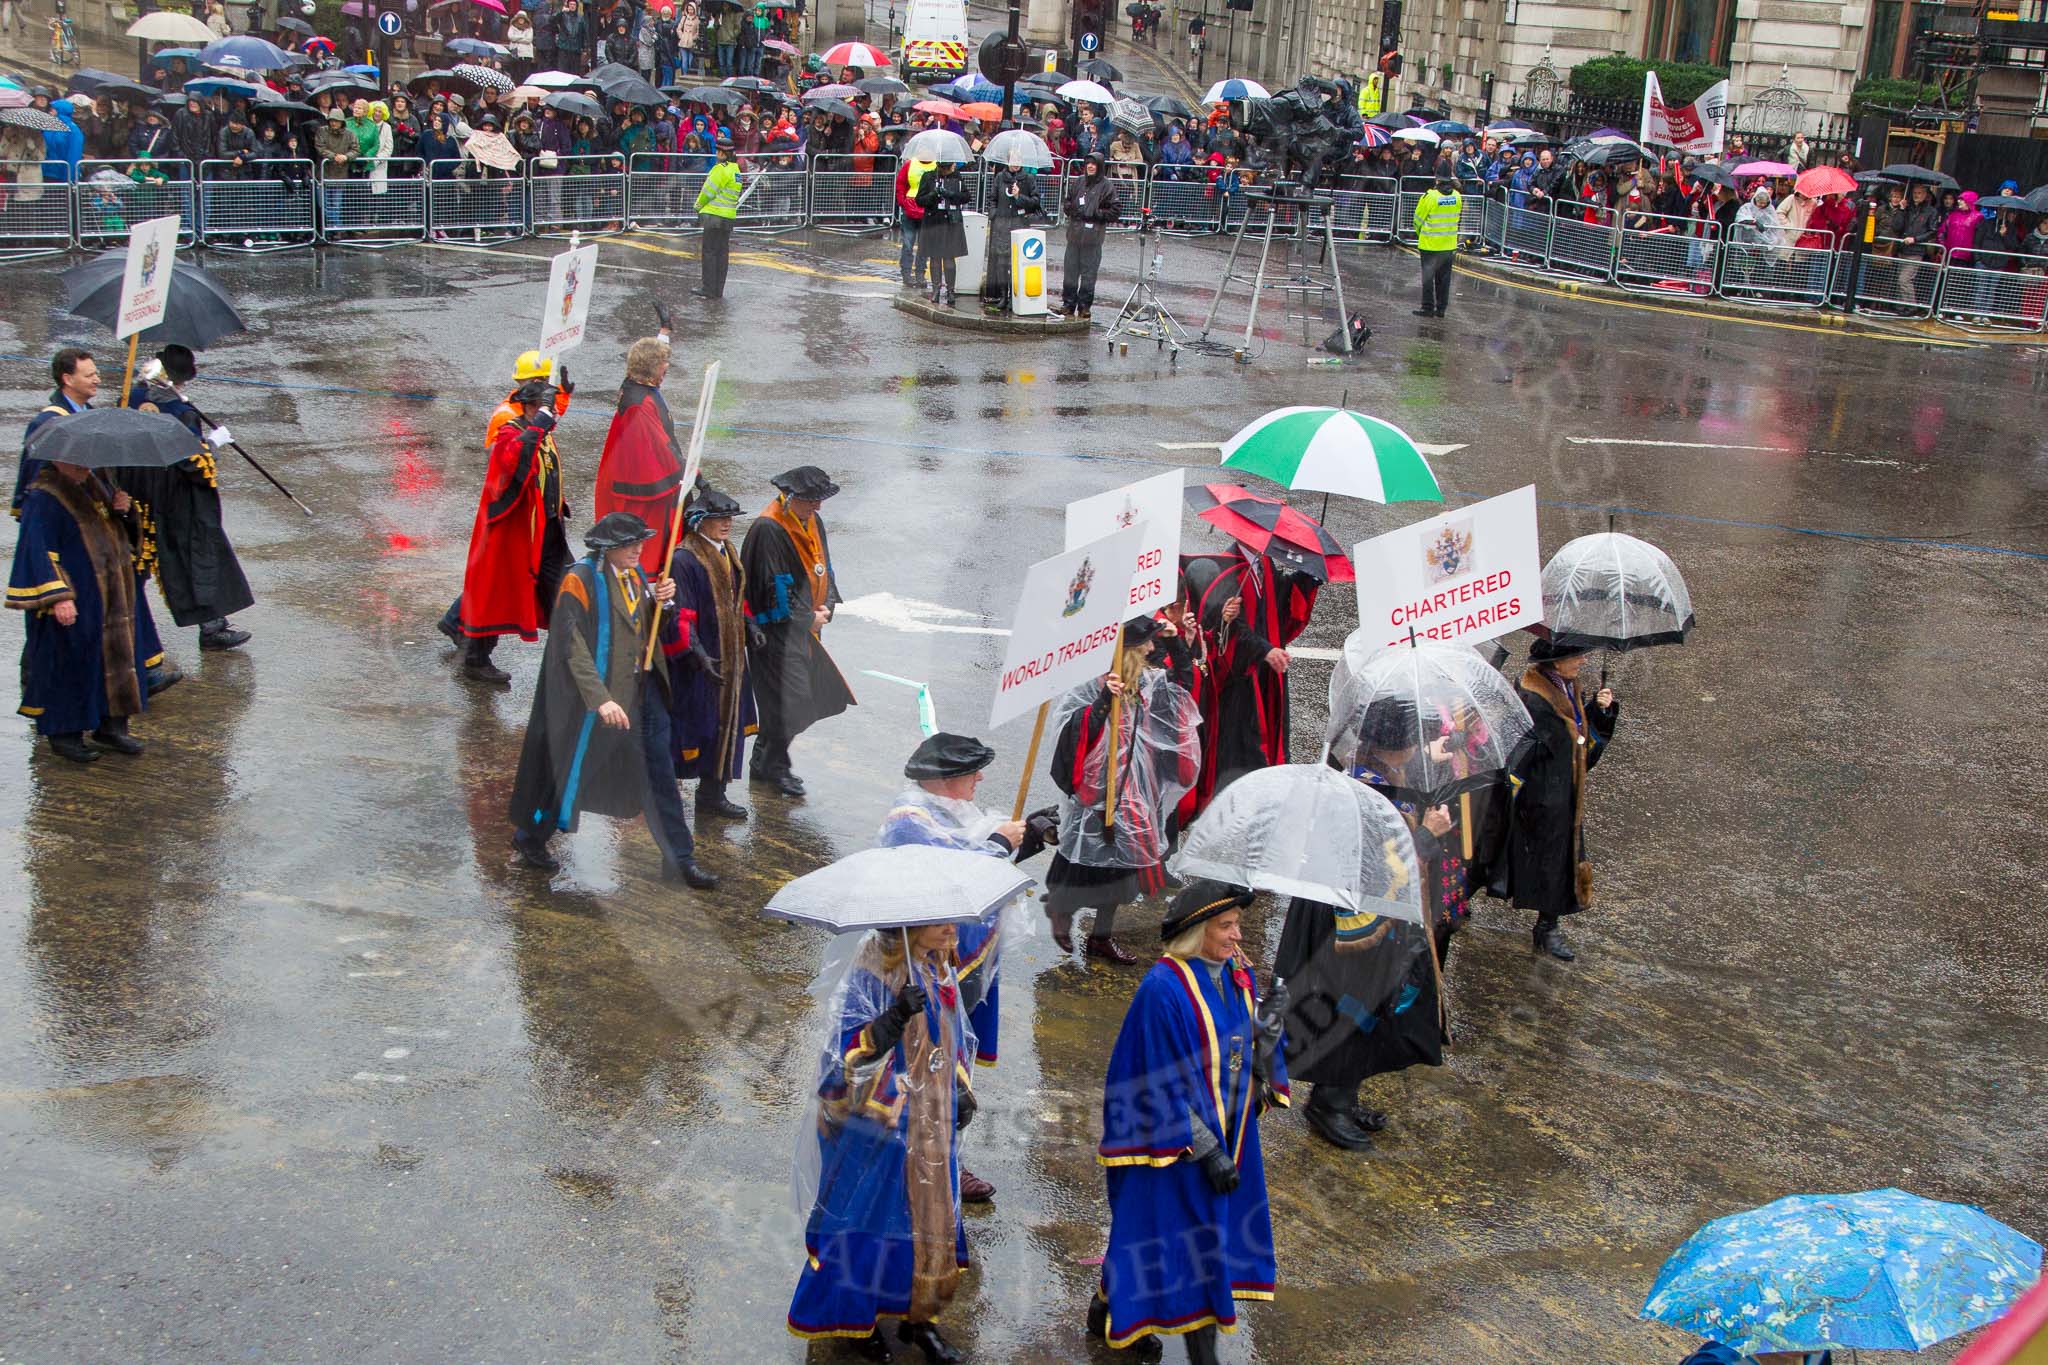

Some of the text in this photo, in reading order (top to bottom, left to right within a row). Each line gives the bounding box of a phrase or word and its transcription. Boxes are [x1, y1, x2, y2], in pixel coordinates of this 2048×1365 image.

[1668, 126, 1697, 138] ANCER
[1387, 598, 1521, 647] RETARIES
[1391, 570, 1511, 626] CHARTERED
[1001, 622, 1118, 692] WORLD TRADERS
